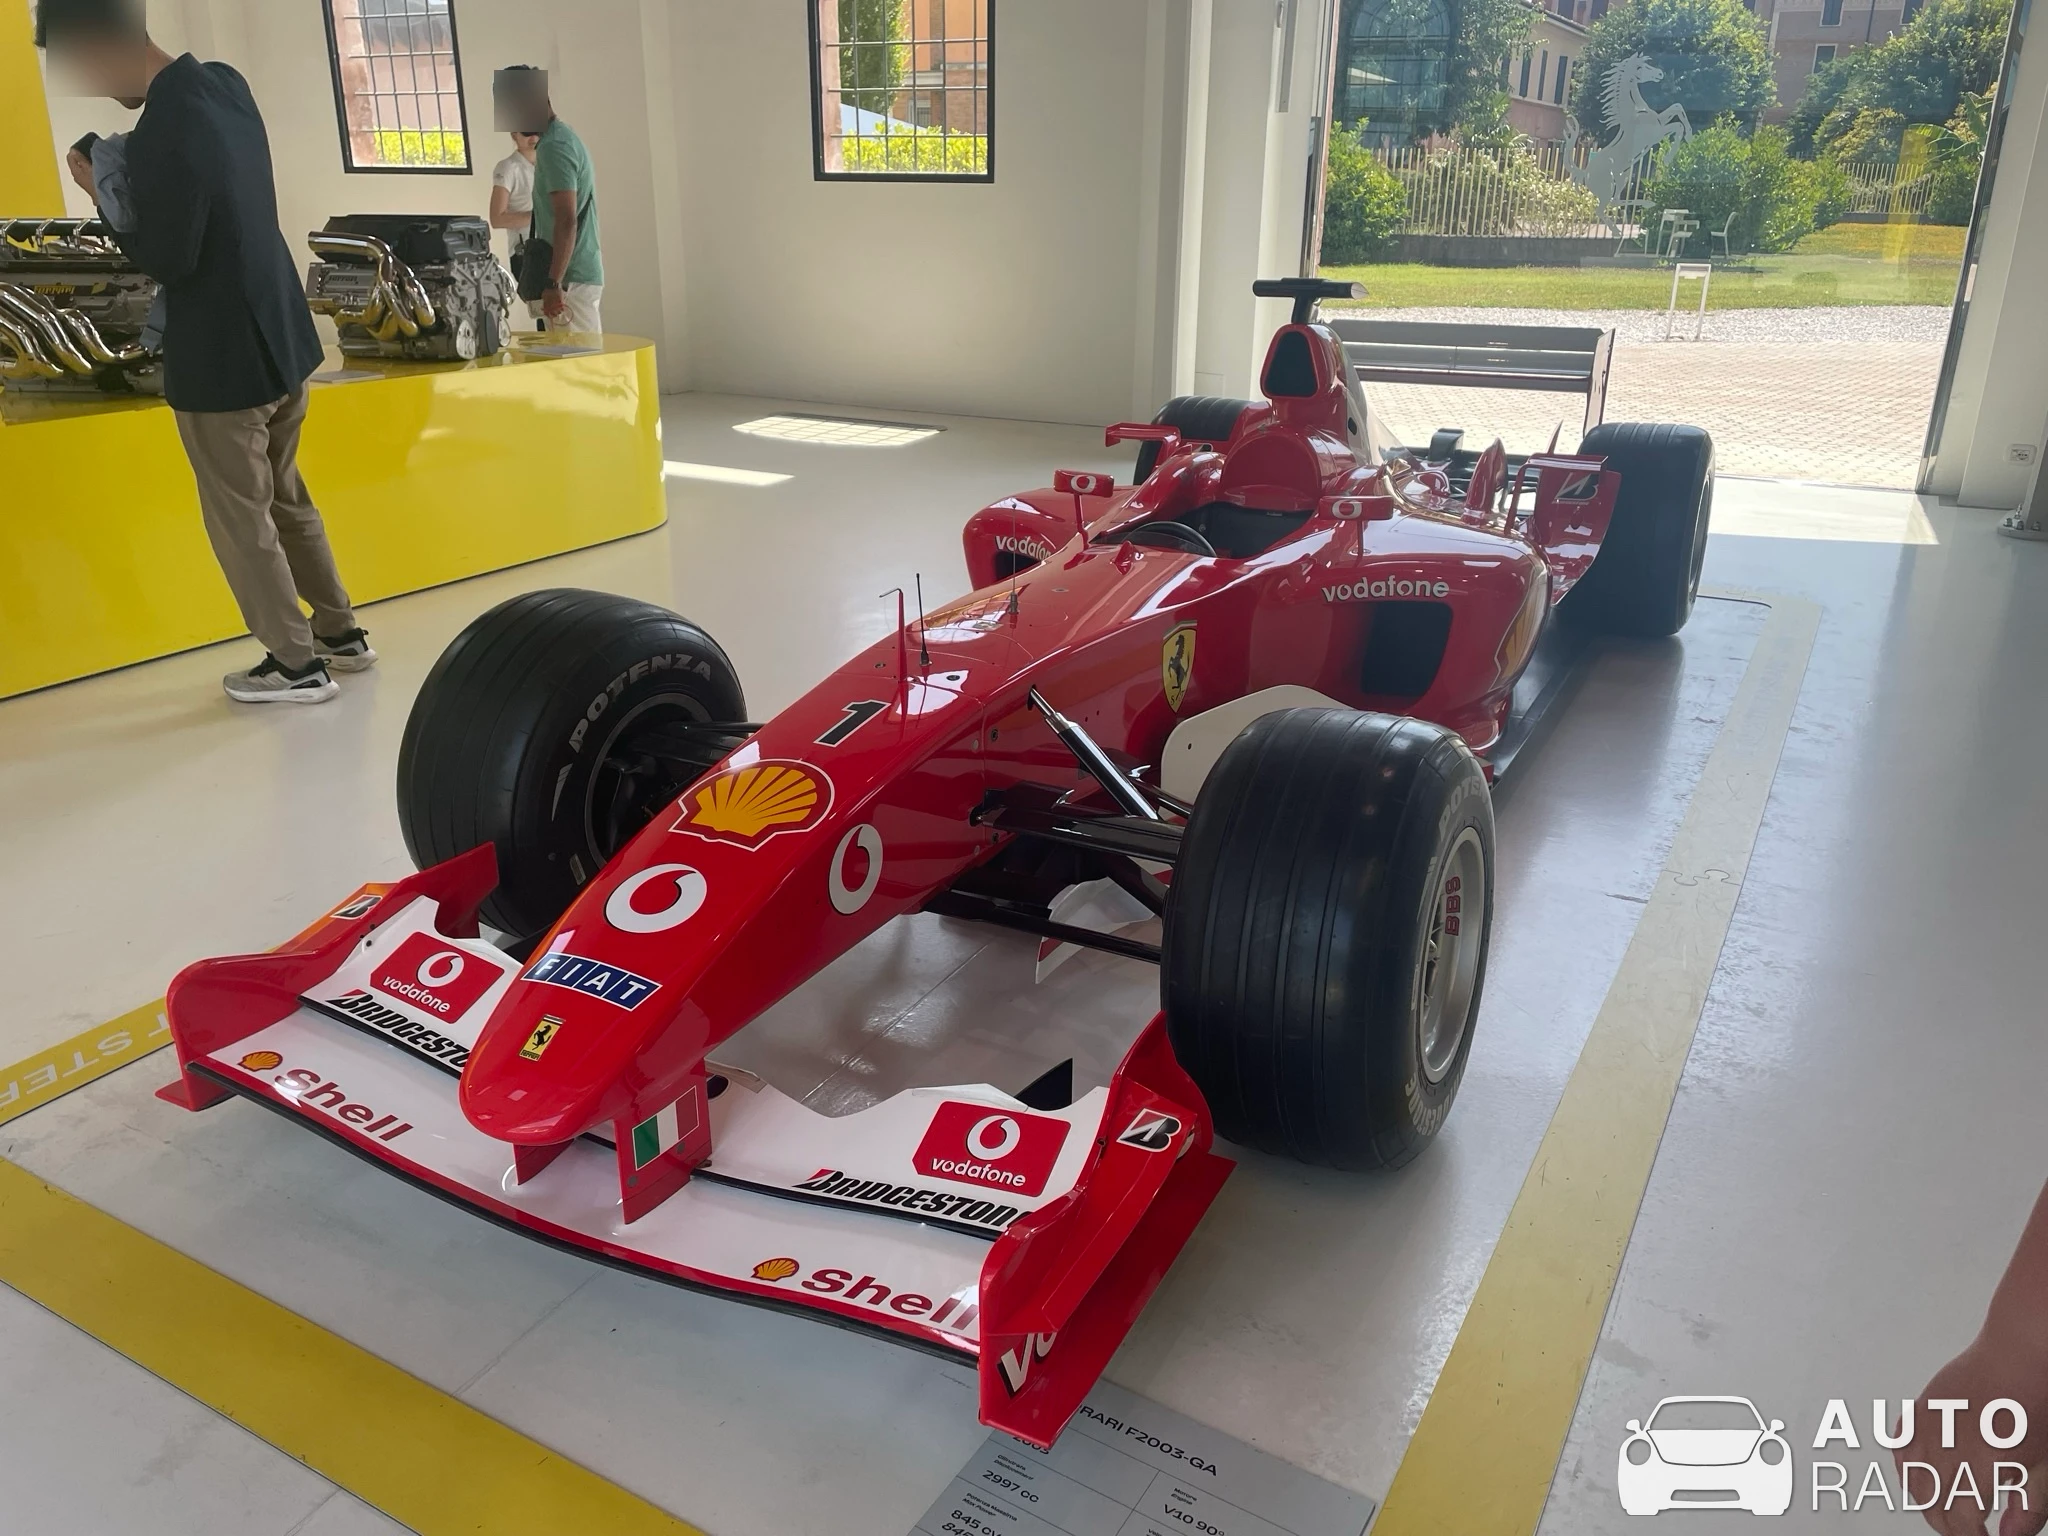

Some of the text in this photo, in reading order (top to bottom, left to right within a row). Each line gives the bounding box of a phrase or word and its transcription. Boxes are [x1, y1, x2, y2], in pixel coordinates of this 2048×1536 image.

[1321, 574, 1450, 602] vodafone
[568, 653, 711, 754] POTENZA
[814, 699, 891, 748] 1
[1445, 876, 1461, 936] BBS
[382, 975, 451, 1013] vodafone
[534, 958, 648, 1000] FIAT
[274, 1068, 414, 1142] Shell
[931, 1157, 1026, 1187] vodafone
[801, 1268, 979, 1331] Shell
[1078, 1404, 1217, 1477] RARI F2003-GA
[982, 1470, 1021, 1492] 2997
[951, 1509, 981, 1529] 845
[1163, 1503, 1194, 1525] V10
